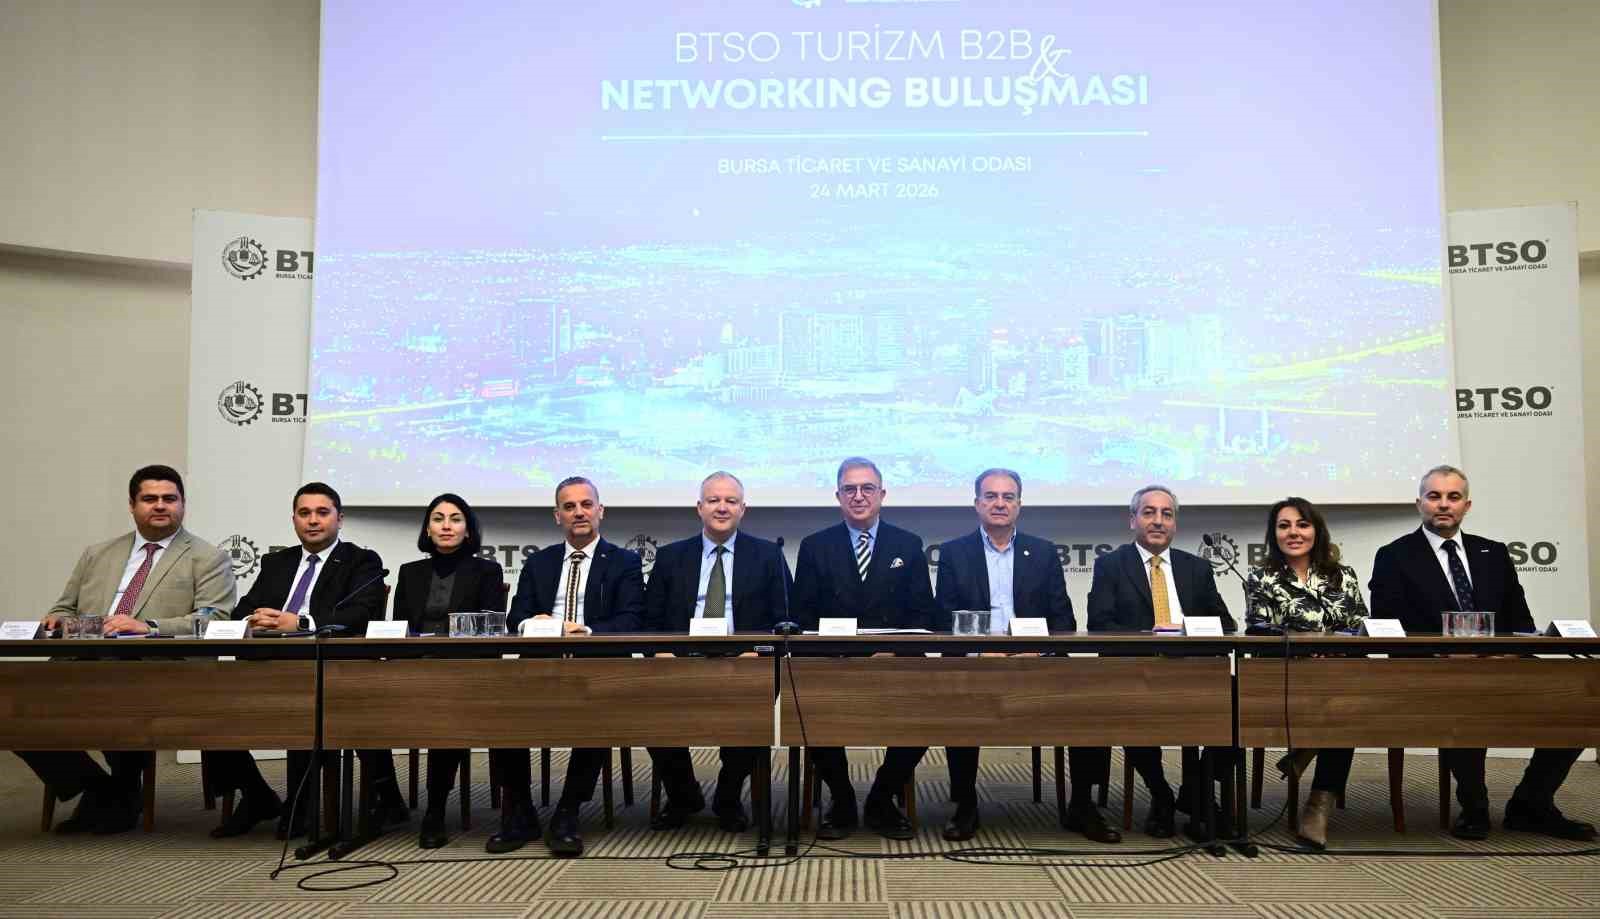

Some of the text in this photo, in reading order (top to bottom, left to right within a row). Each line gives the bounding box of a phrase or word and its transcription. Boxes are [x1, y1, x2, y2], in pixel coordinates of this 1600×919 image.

[676, 24, 1072, 83] BTSO TURİZM B2B &
[601, 75, 1148, 115] NETWORKING BULUŞMASI
[718, 158, 783, 174] BURSA
[868, 157, 891, 174] VE
[972, 156, 1031, 172] ODASI
[810, 183, 939, 199] 24 MART 2026
[277, 250, 314, 273] BT
[1448, 240, 1546, 267] BTSO
[272, 393, 308, 416] BT
[1456, 386, 1551, 411] BTSO
[480, 545, 540, 567] BTS
[1056, 544, 1113, 566] BTS
[1508, 542, 1557, 565] SO
